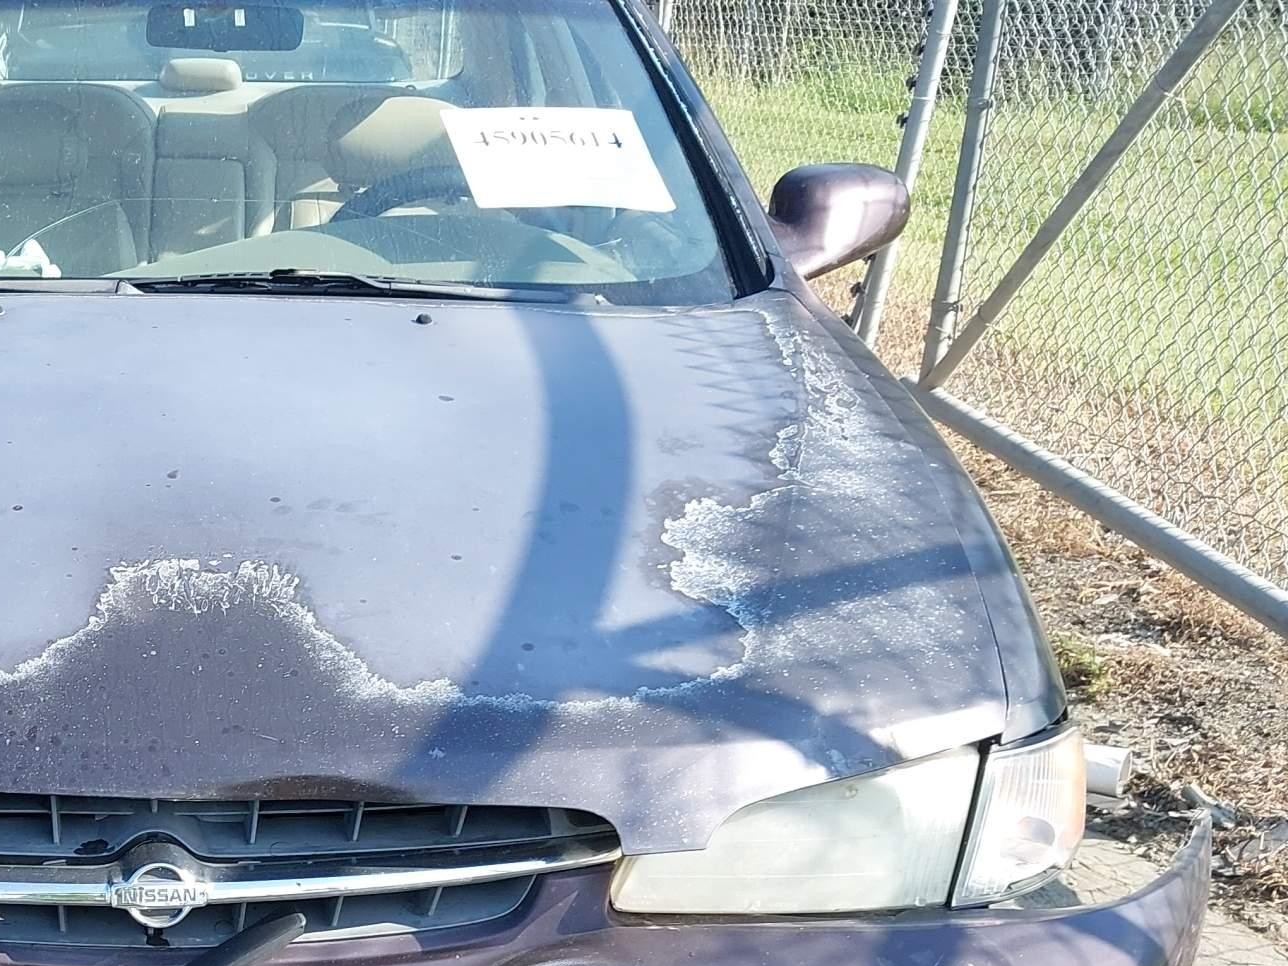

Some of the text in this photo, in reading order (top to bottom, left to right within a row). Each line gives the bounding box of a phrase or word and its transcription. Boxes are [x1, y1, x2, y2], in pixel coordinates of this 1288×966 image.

[245, 71, 314, 80] OVER
[473, 130, 623, 149] 45905614
[121, 886, 196, 904] NISSAN
